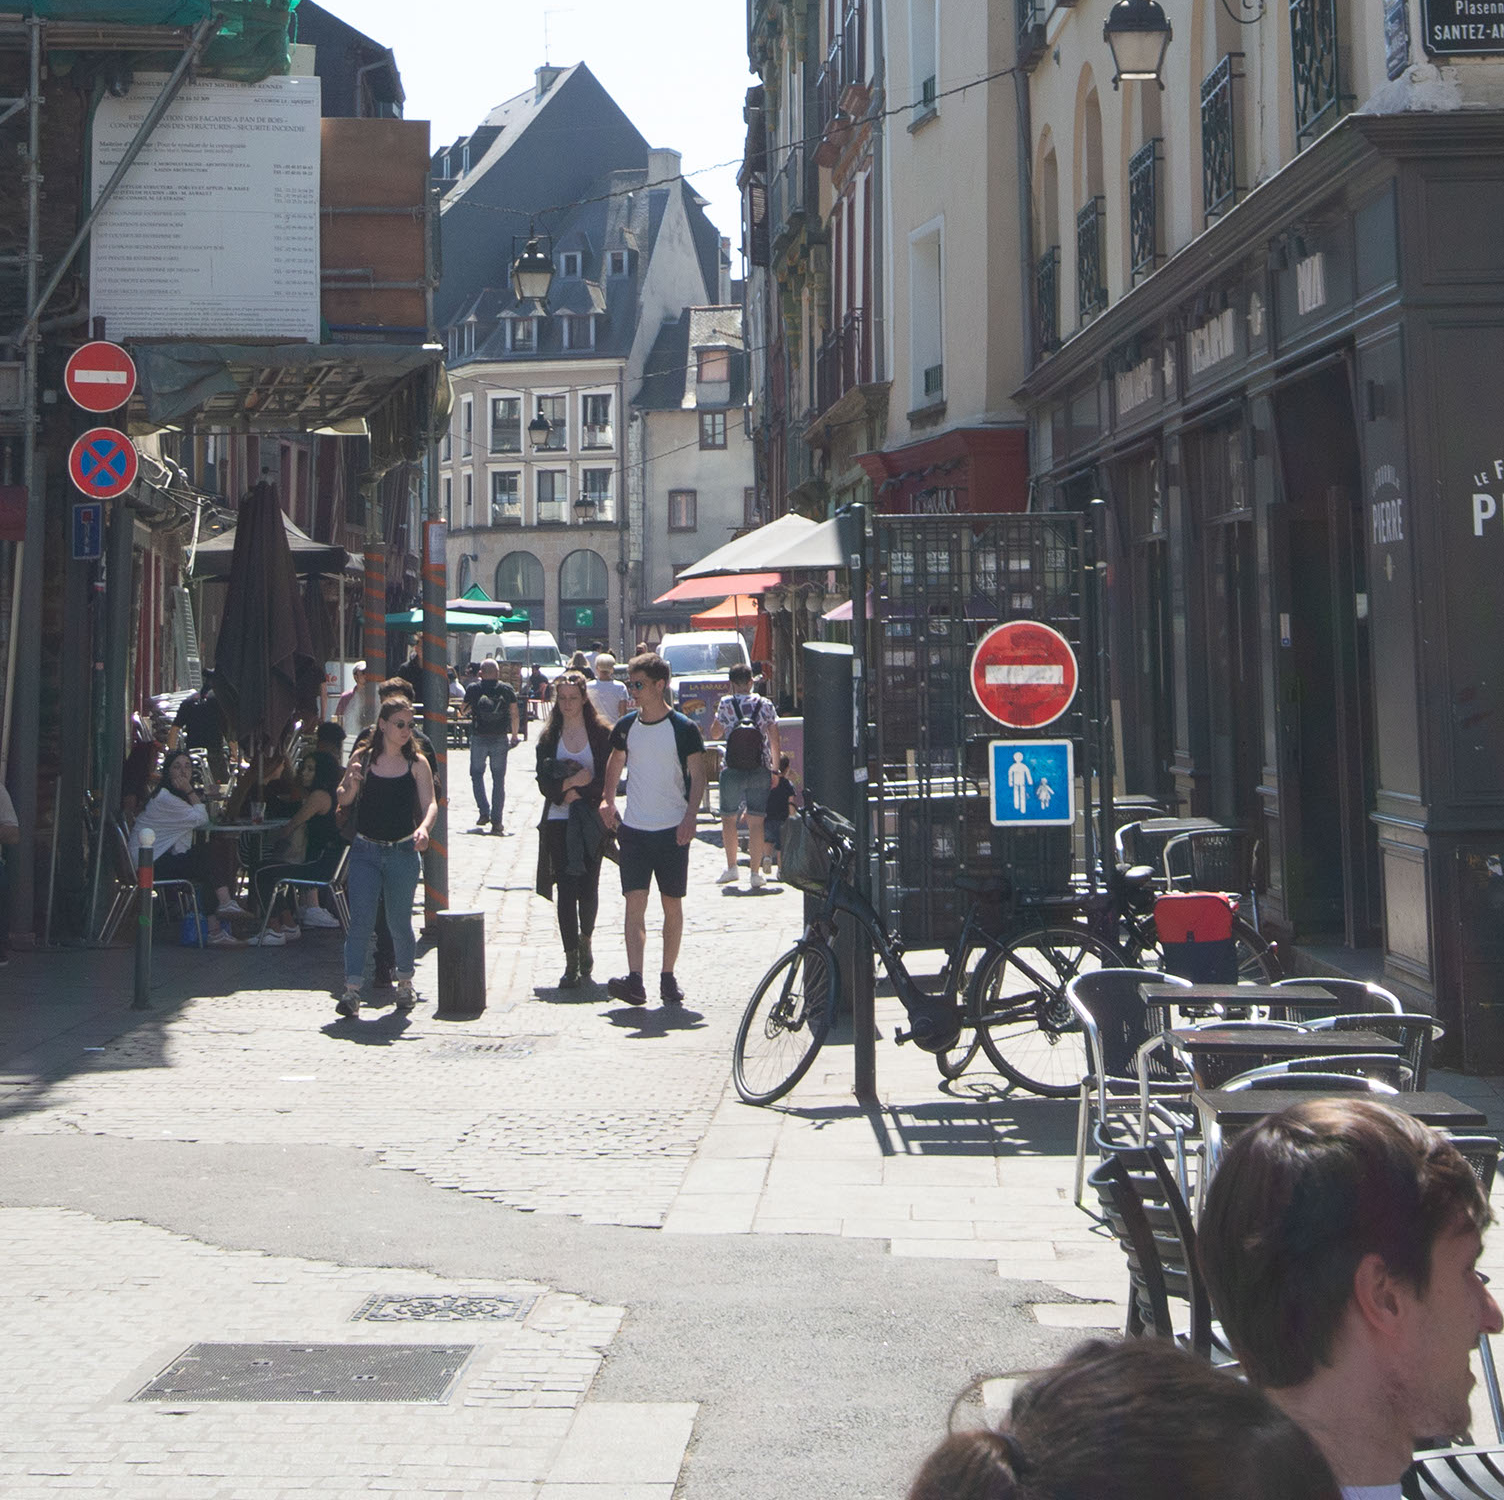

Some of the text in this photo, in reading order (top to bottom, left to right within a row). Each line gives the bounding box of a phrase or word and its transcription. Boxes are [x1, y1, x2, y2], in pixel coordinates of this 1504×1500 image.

[1455, 0, 1504, 15] Plasenn
[1473, 471, 1490, 487] LE
[1372, 498, 1404, 545] PIERRE
